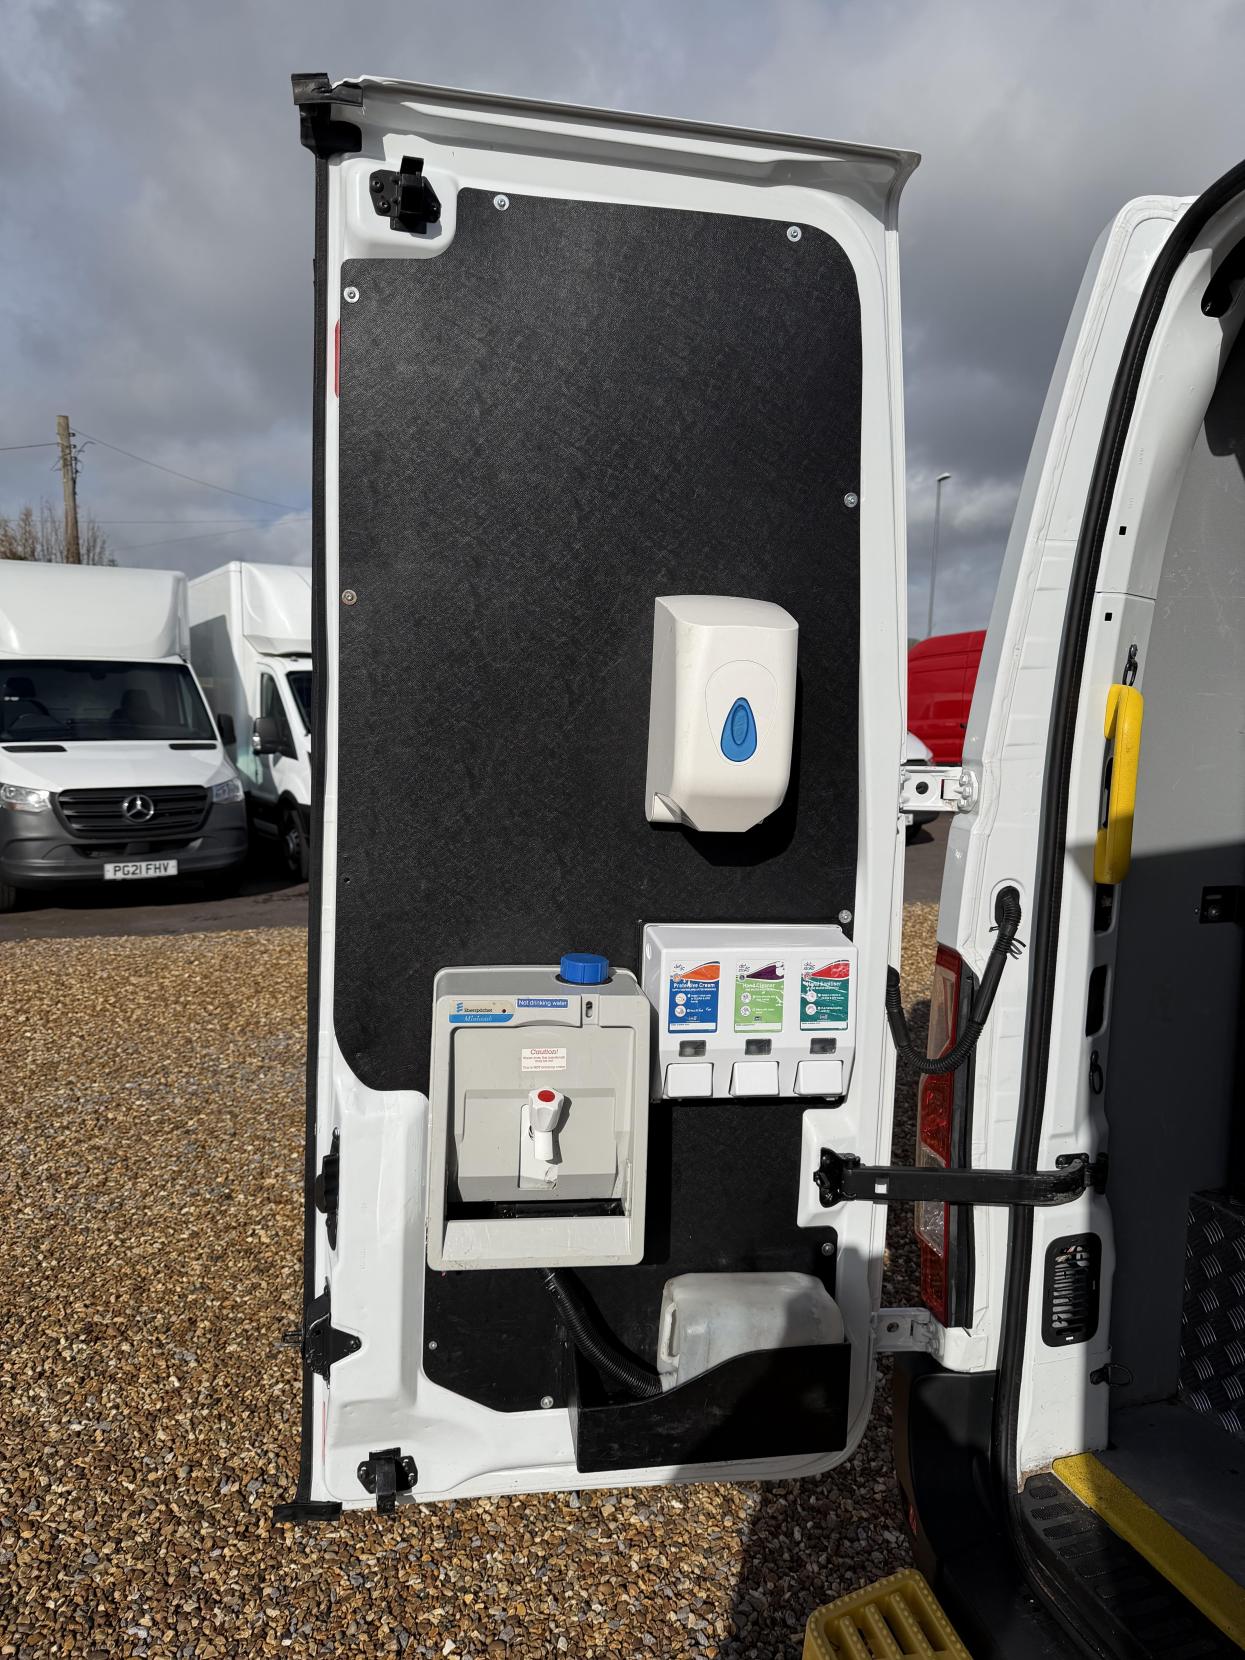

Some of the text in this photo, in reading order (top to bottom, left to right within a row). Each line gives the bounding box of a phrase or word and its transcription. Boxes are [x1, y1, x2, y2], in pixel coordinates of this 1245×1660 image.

[113, 862, 169, 876] PG21 FHV
[529, 999, 552, 1008] drinking
